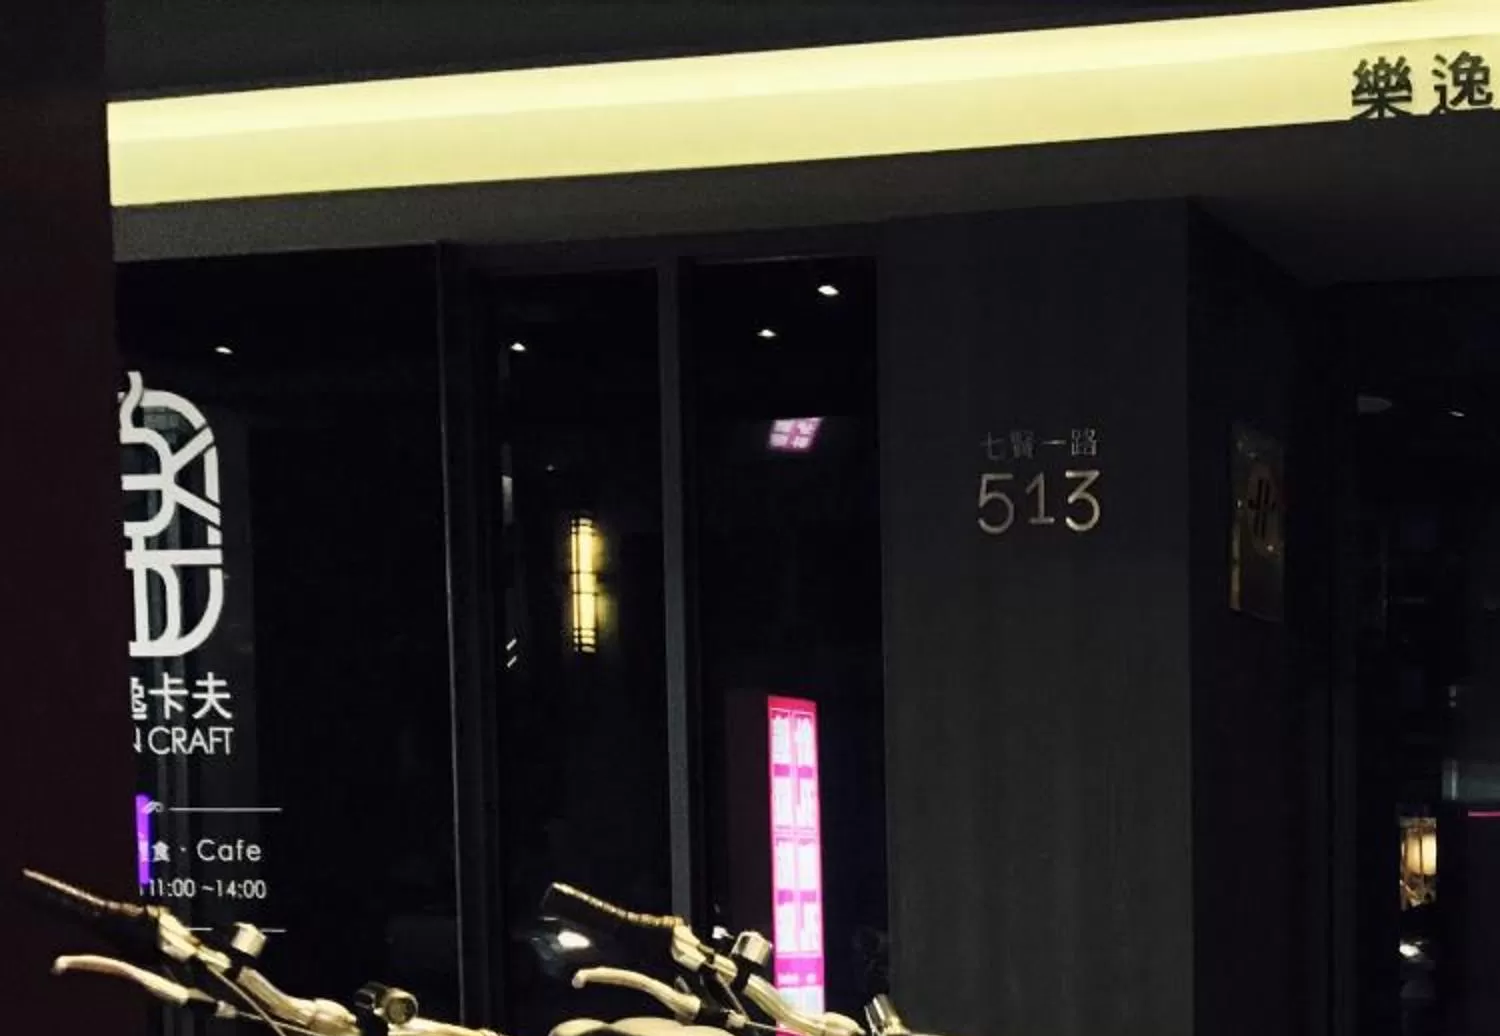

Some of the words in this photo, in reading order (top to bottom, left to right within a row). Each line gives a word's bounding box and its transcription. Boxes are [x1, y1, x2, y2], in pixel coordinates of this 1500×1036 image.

[1351, 50, 1494, 118] 樂逸
[977, 469, 1102, 535] 513
[147, 726, 235, 755] CRAFT
[196, 838, 262, 863] Cafe
